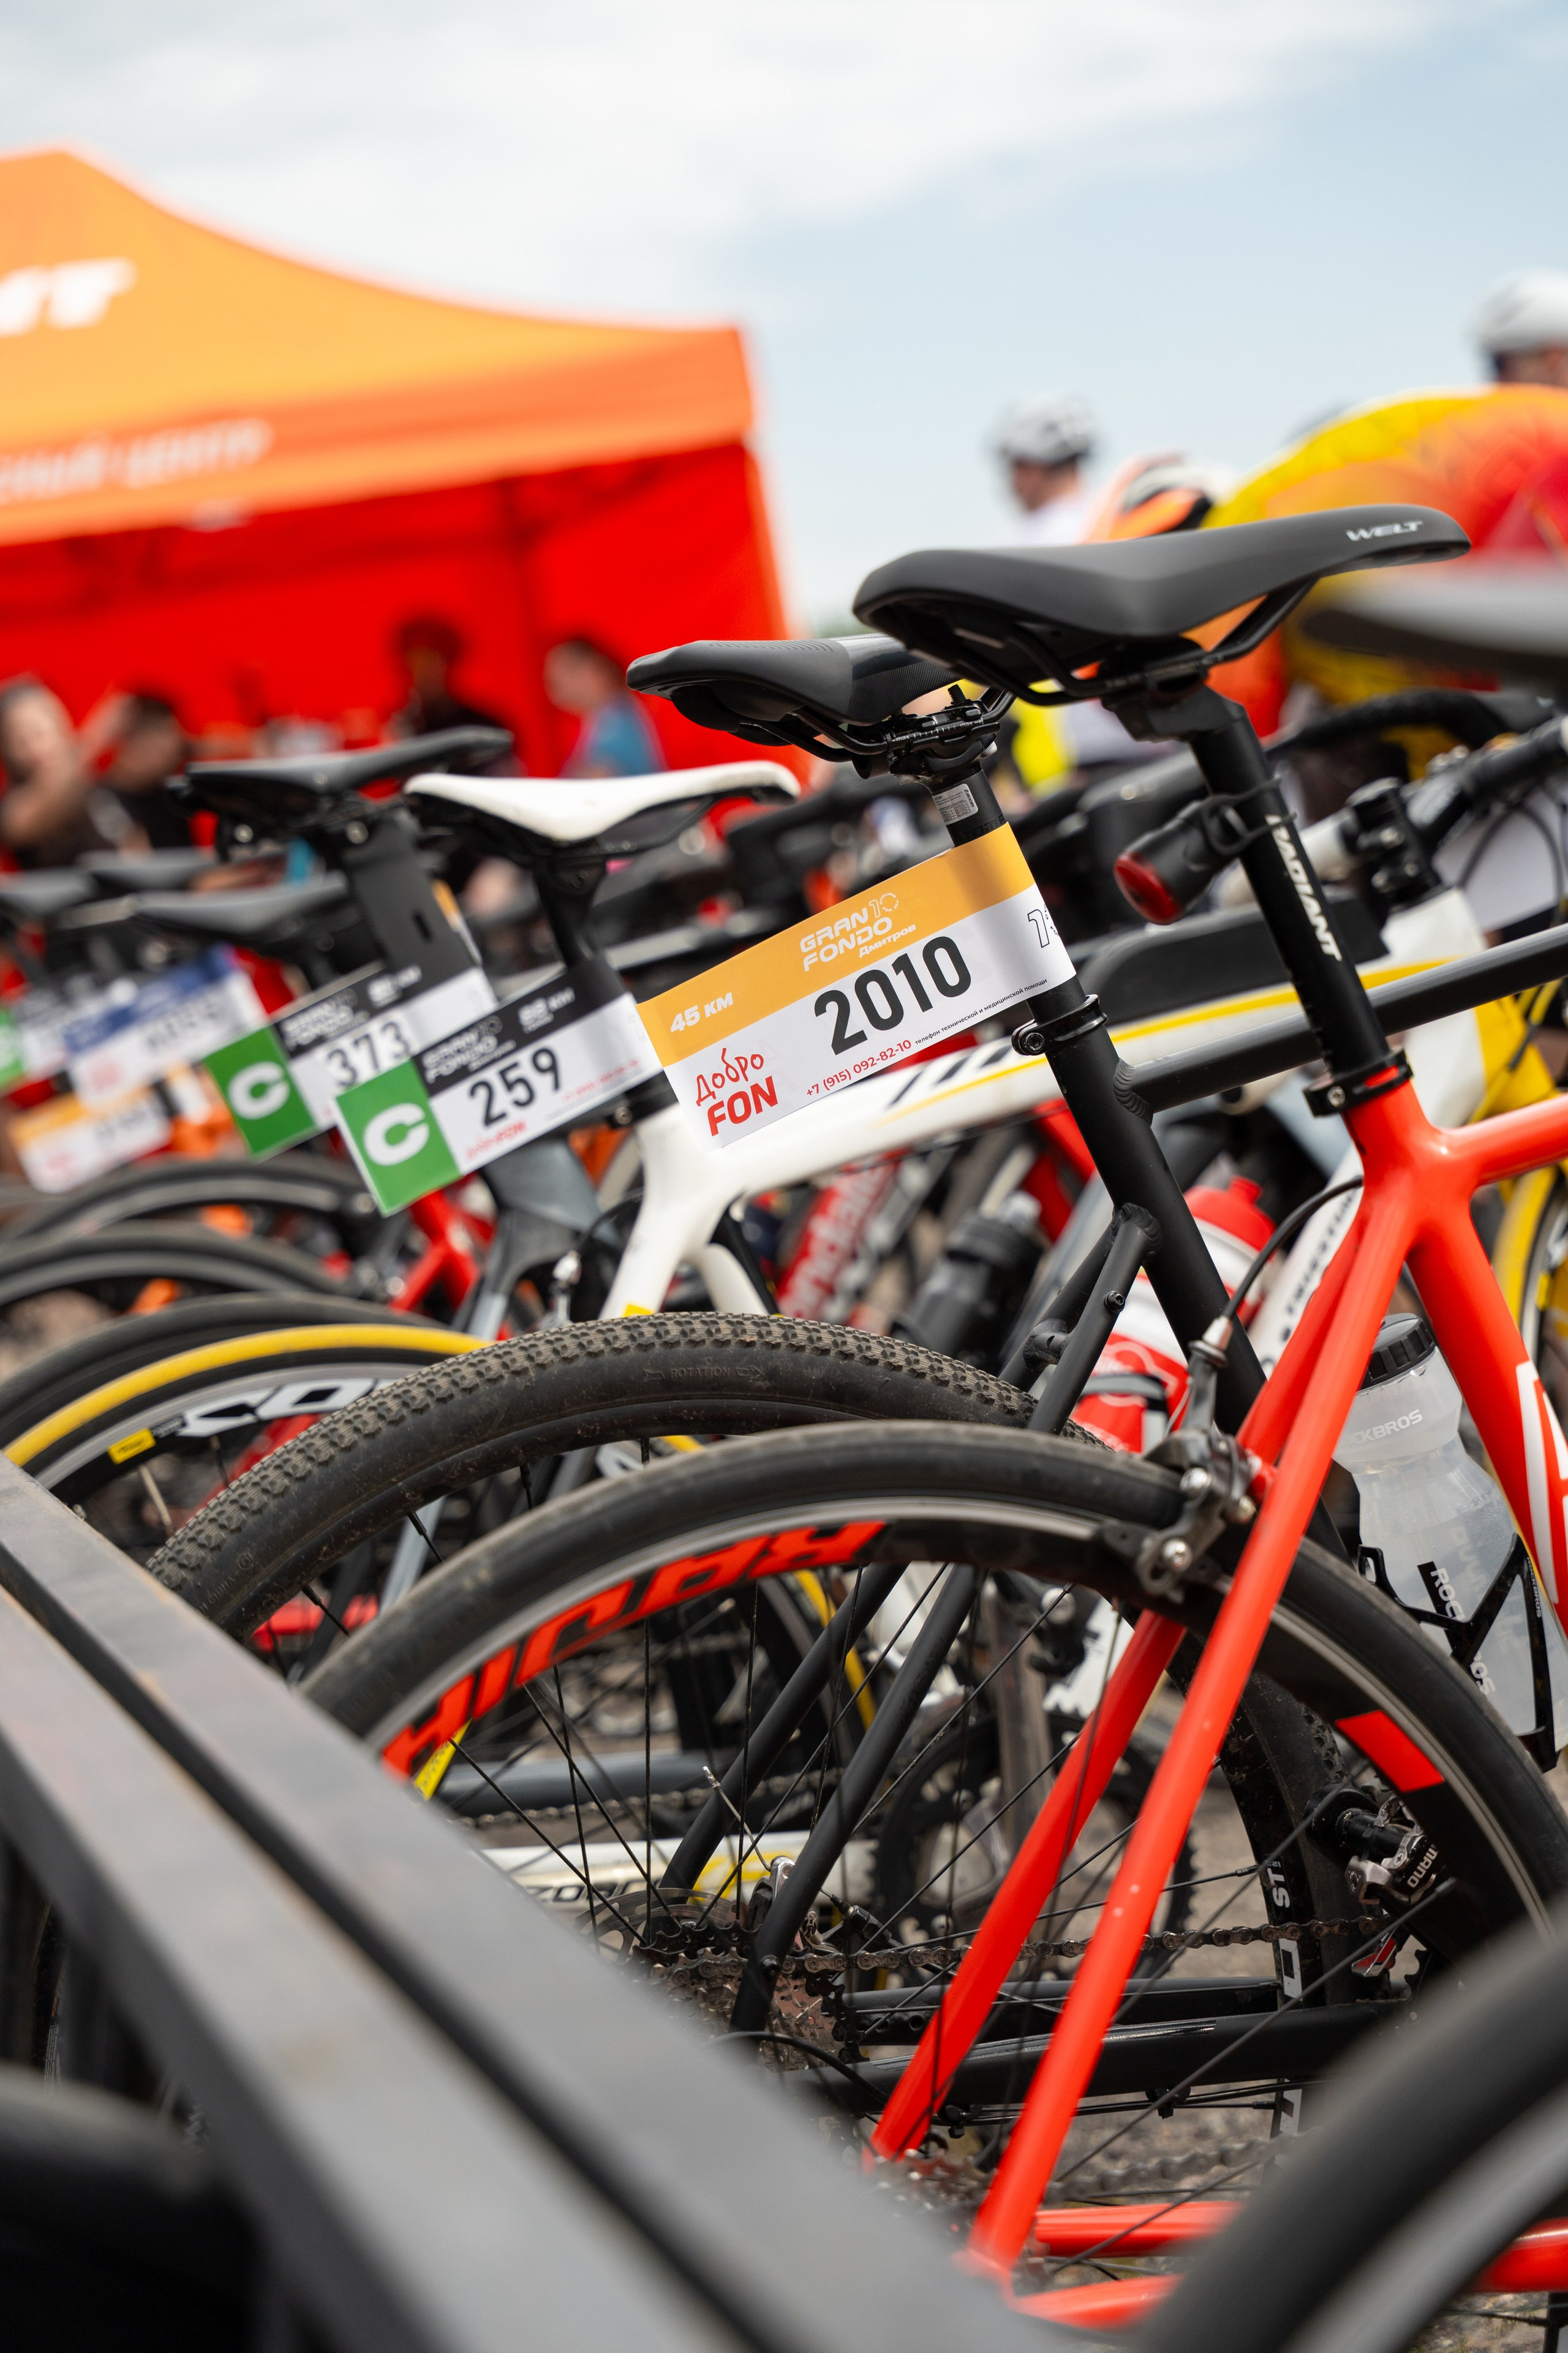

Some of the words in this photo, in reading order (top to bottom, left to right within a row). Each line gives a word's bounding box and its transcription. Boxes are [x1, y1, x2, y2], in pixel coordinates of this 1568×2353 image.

[1346, 520, 1423, 542] WELT
[1264, 814, 1343, 962] RADIANT
[800, 907, 869, 953] GRAN
[803, 916, 892, 972] FONDO
[859, 924, 916, 959] Дмитров
[670, 1004, 701, 1033] 45
[814, 936, 971, 1056] 2010
[915, 1029, 941, 1045] телефон
[941, 1010, 979, 1032] технической
[984, 988, 1023, 1011] медицинской
[1024, 978, 1048, 992] помощи
[326, 1021, 411, 1087] 373
[696, 1048, 764, 1107] Добро
[806, 1083, 820, 1097] +7
[823, 1068, 852, 1091] (915)
[853, 1039, 911, 1075] 092-82-10
[228, 1061, 290, 1120] C
[470, 1048, 560, 1127] 259
[707, 1076, 778, 1136] FON
[363, 1103, 430, 1166] C
[670, 1367, 731, 1378] ROTATION
[1407, 1843, 1439, 1888] MANO
